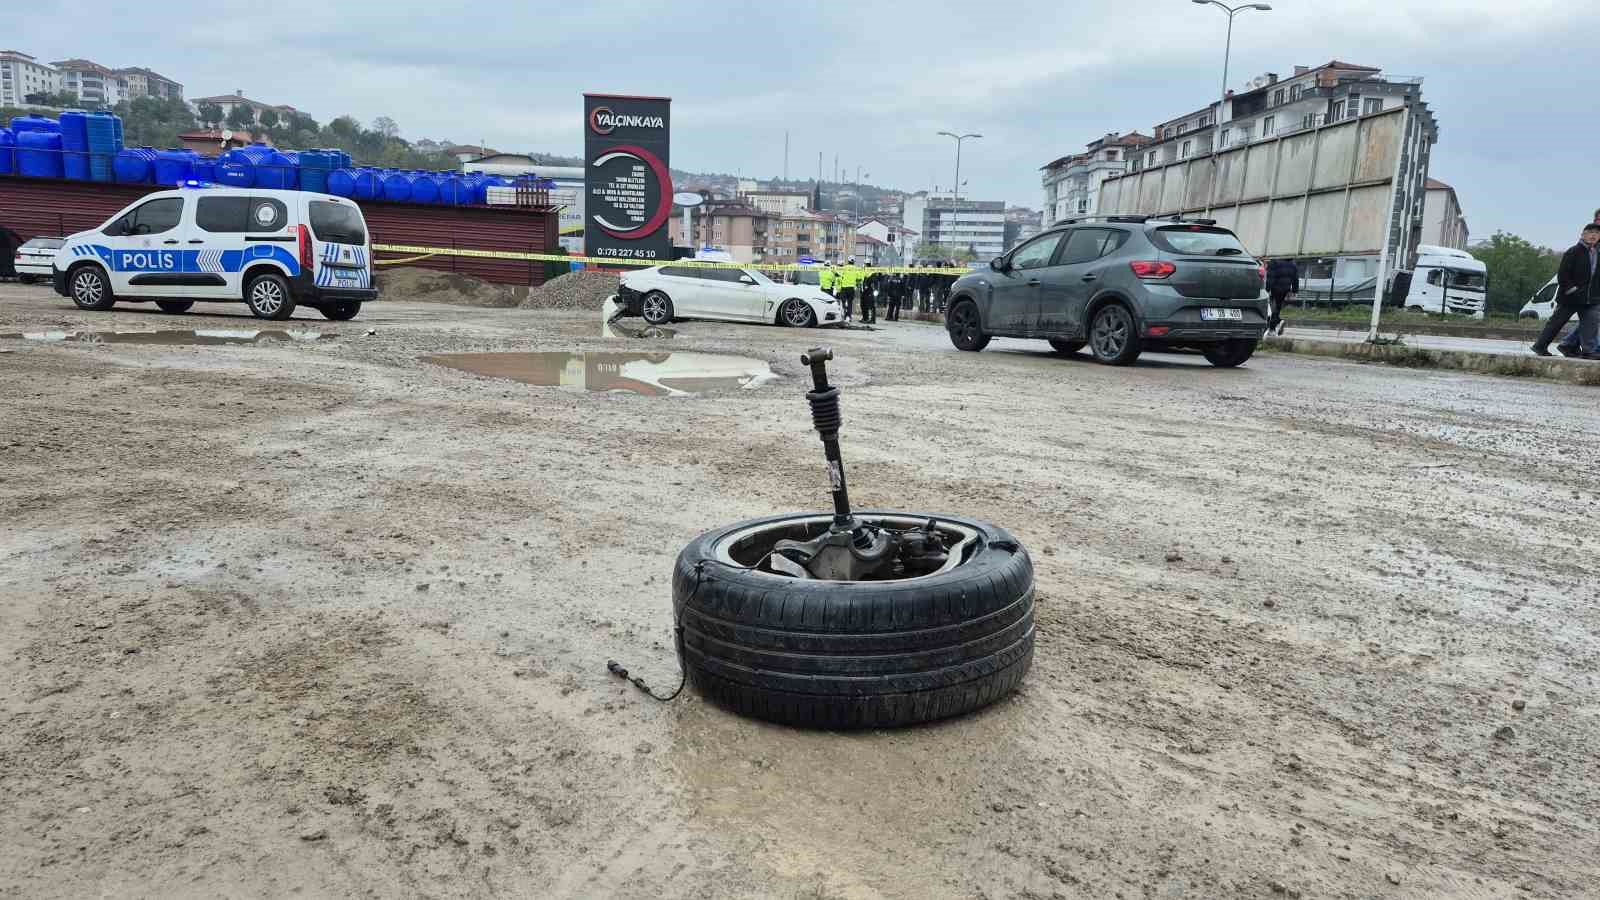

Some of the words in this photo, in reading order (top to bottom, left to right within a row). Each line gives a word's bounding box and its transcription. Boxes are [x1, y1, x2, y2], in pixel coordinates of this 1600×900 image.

[596, 114, 664, 128] YALÇINKAYA
[123, 250, 174, 269] POLİS
[645, 250, 656, 258] 10
